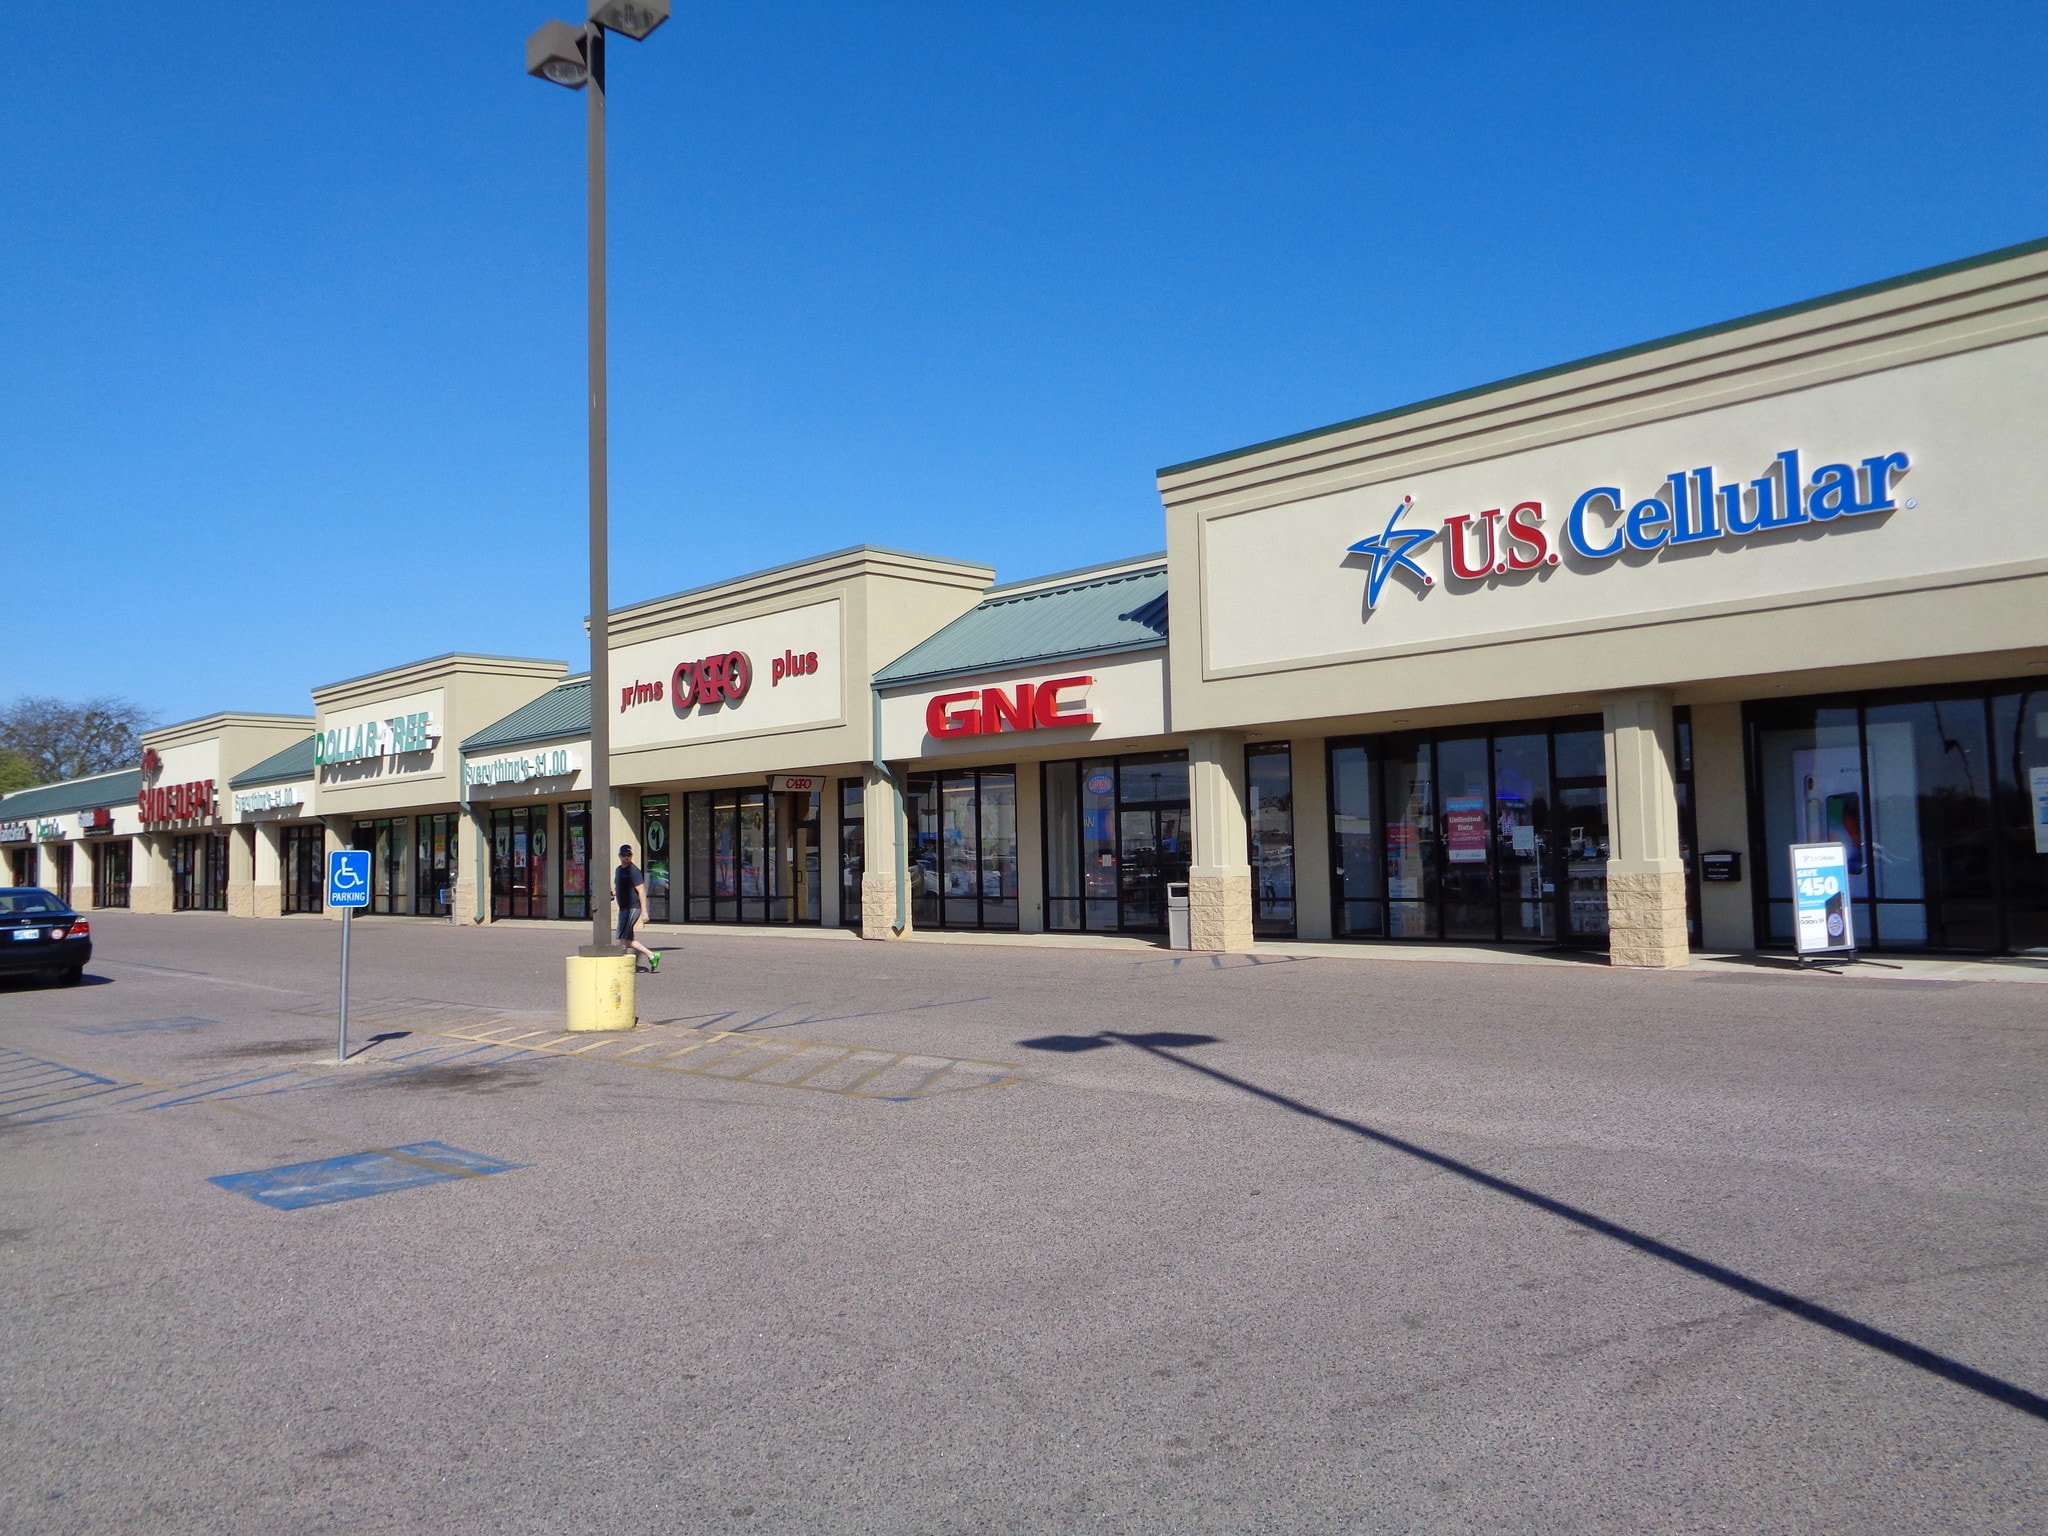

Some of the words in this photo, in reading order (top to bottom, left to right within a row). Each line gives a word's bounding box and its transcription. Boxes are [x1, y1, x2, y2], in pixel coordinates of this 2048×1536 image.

[1442, 501, 1563, 580] U.S.
[1565, 447, 1913, 560] Cellular
[620, 679, 664, 713] jr/ms
[670, 650, 749, 711] CATO
[771, 649, 819, 687] plus
[925, 675, 1096, 740] GNC
[314, 719, 382, 766] DOLLAR
[377, 711, 437, 757] TREE
[785, 777, 812, 789] CATO
[137, 785, 176, 824] SHOE
[1448, 815, 1482, 824] Unlimited
[1457, 824, 1474, 832] Data
[331, 890, 366, 903] PARKING
